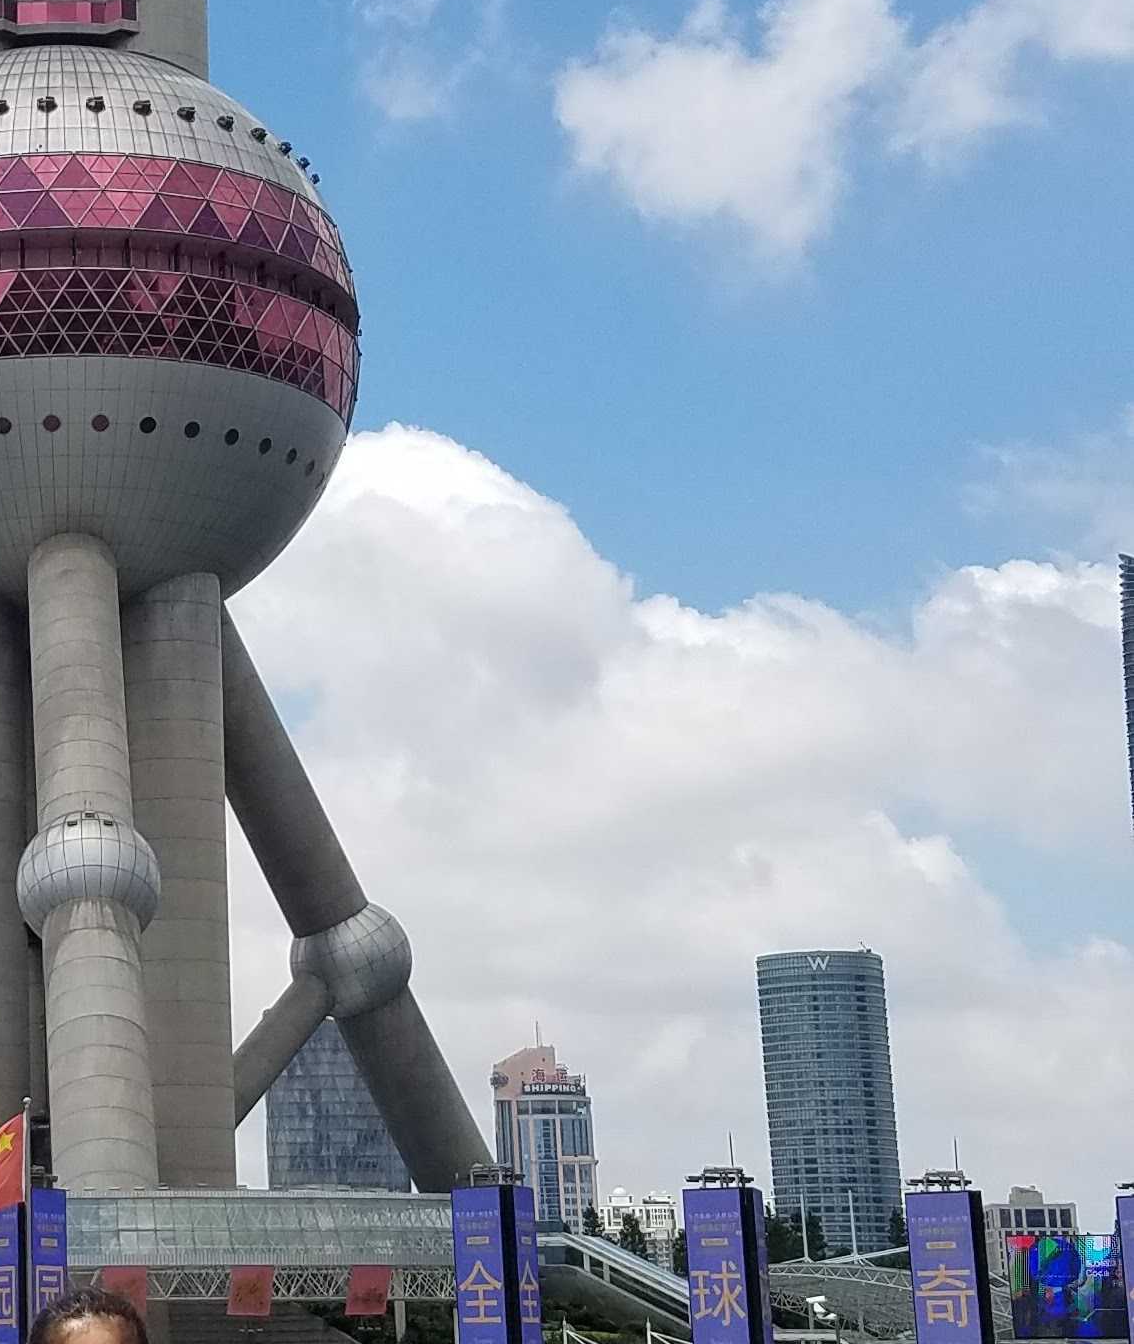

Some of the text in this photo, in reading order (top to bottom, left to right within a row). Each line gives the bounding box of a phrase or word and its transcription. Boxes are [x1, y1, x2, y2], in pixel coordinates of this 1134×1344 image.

[806, 955, 830, 971] W
[523, 1084, 577, 1093] SHIPPING
[459, 1260, 503, 1324] 全
[519, 1260, 540, 1324] 全
[690, 1260, 747, 1327] 球
[915, 1263, 976, 1328] 奇
